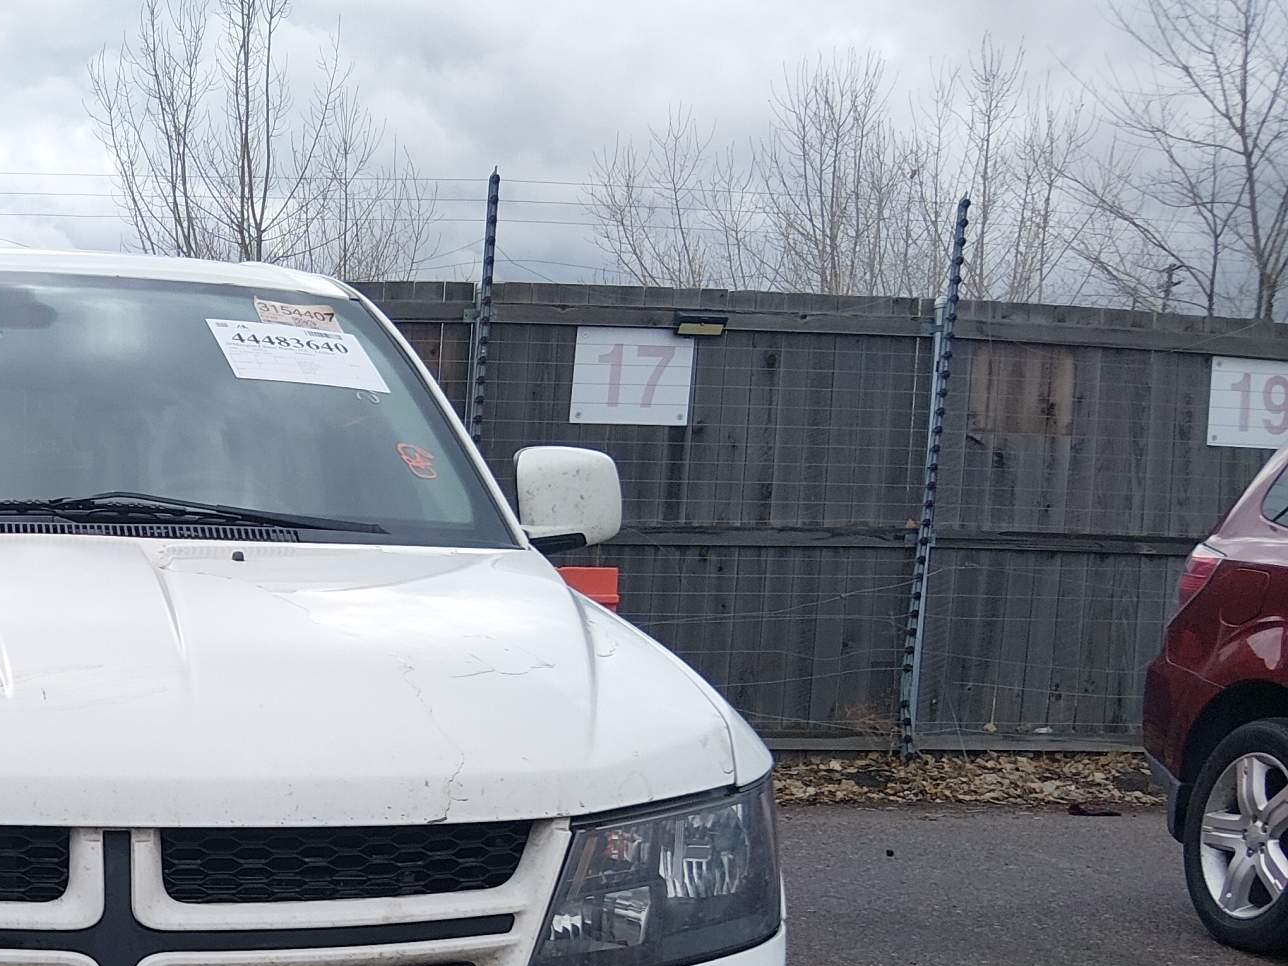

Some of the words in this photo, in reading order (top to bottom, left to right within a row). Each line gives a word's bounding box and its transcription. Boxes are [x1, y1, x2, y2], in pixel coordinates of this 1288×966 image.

[257, 302, 335, 323] 3154407
[232, 332, 349, 354] 44483640
[598, 343, 676, 408] 17
[1231, 372, 1288, 435] 19
